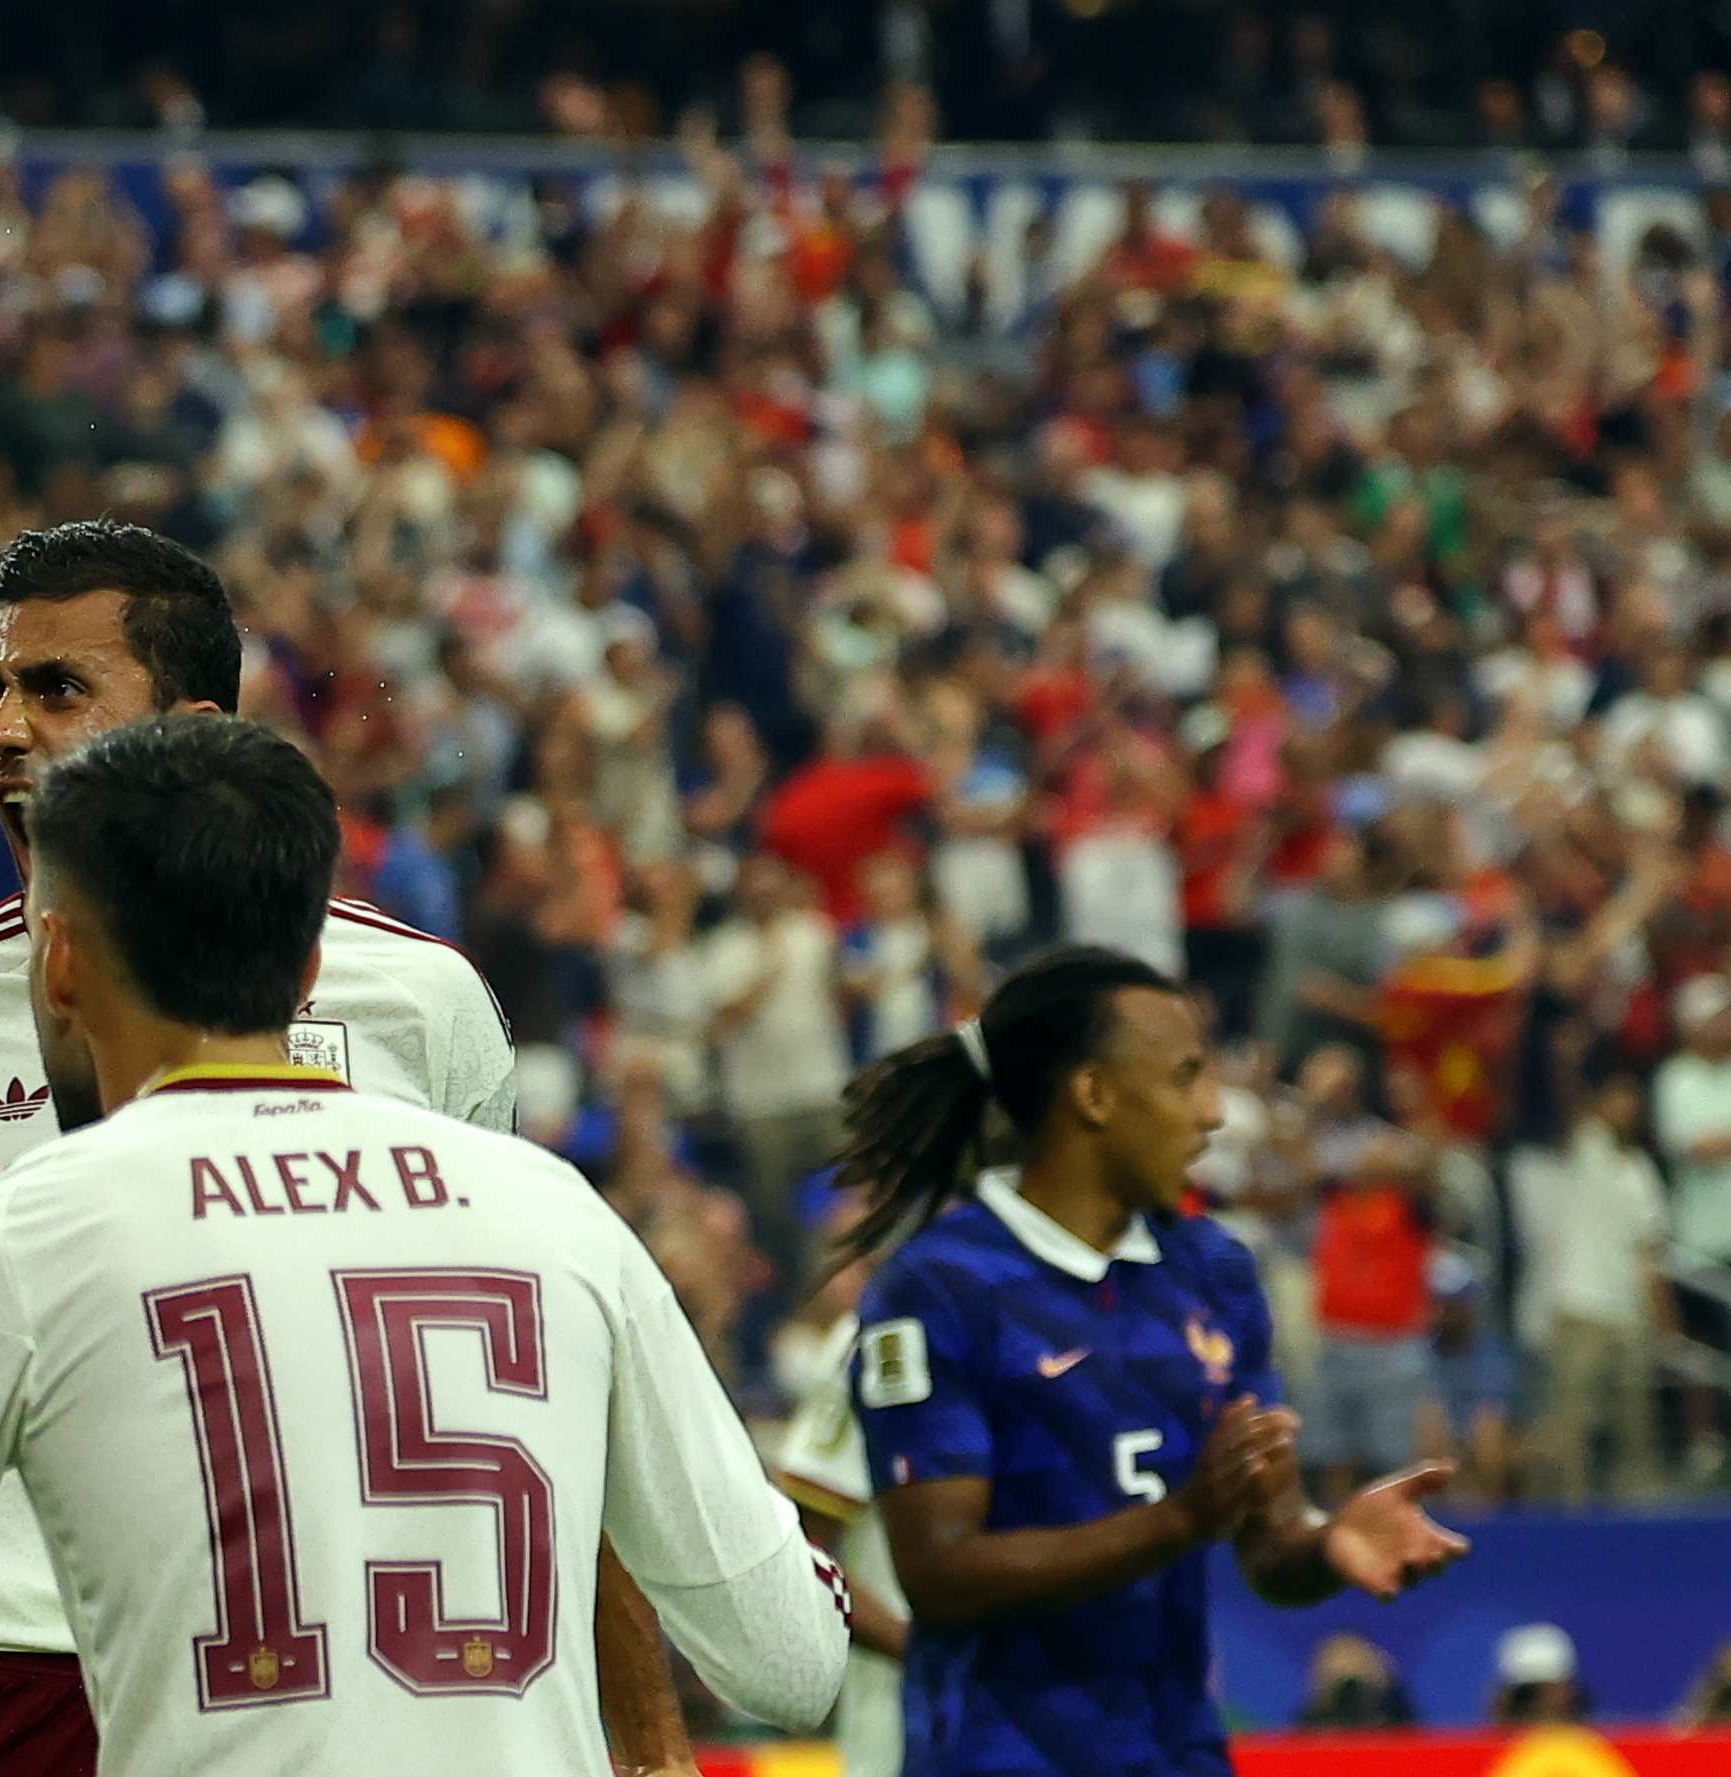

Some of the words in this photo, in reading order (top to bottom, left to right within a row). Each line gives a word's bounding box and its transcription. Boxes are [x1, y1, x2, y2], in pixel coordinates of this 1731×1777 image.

[191, 1149, 381, 1220] ALEX
[390, 1145, 470, 1209] B.
[143, 1268, 557, 1711] 15
[1112, 1426, 1168, 1505] 5
